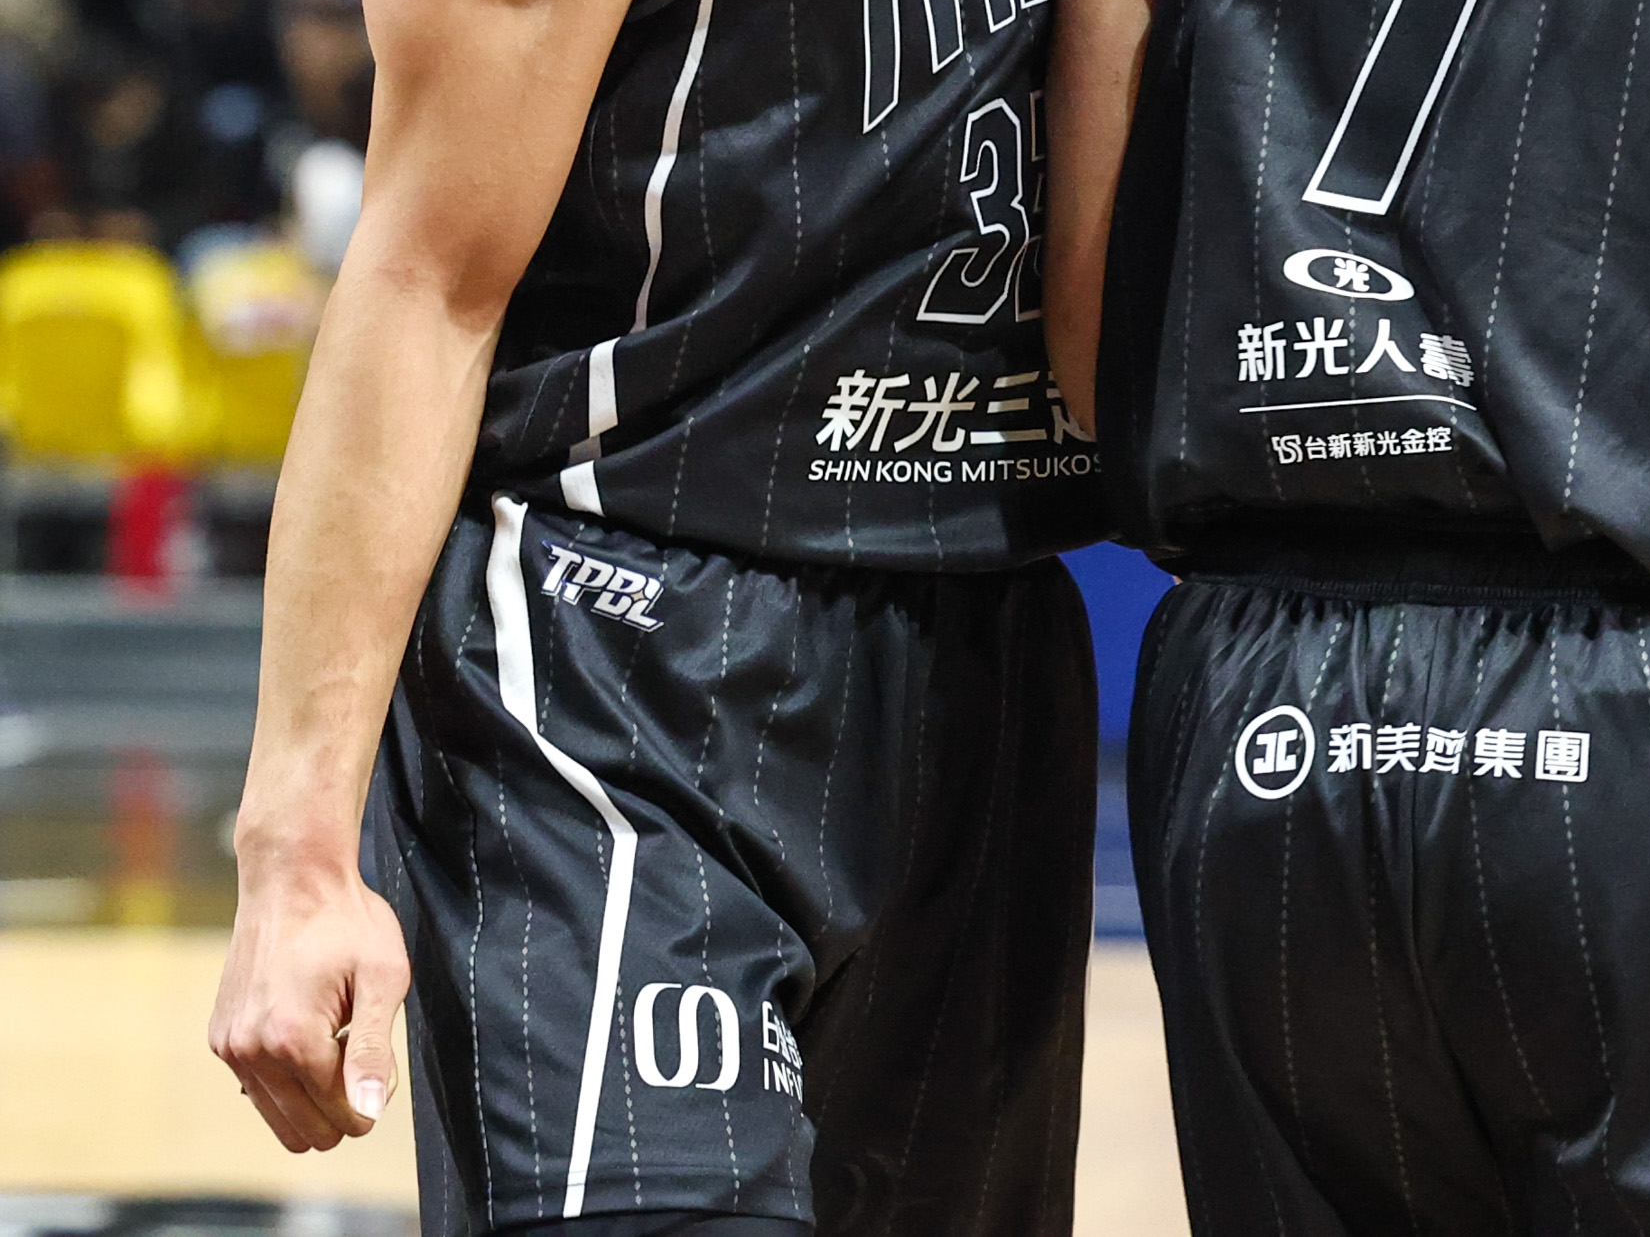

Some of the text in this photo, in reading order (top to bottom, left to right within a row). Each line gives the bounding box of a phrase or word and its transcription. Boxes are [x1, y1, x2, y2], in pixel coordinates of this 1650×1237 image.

[916, 91, 1046, 324] 3
[1238, 317, 1475, 388] 新光人壽
[808, 460, 871, 482] SHIN
[876, 461, 952, 483] KONG
[1304, 427, 1453, 461] 台新新光金控
[541, 539, 665, 633] TPBL
[1327, 722, 1592, 783] 新美齊集團
